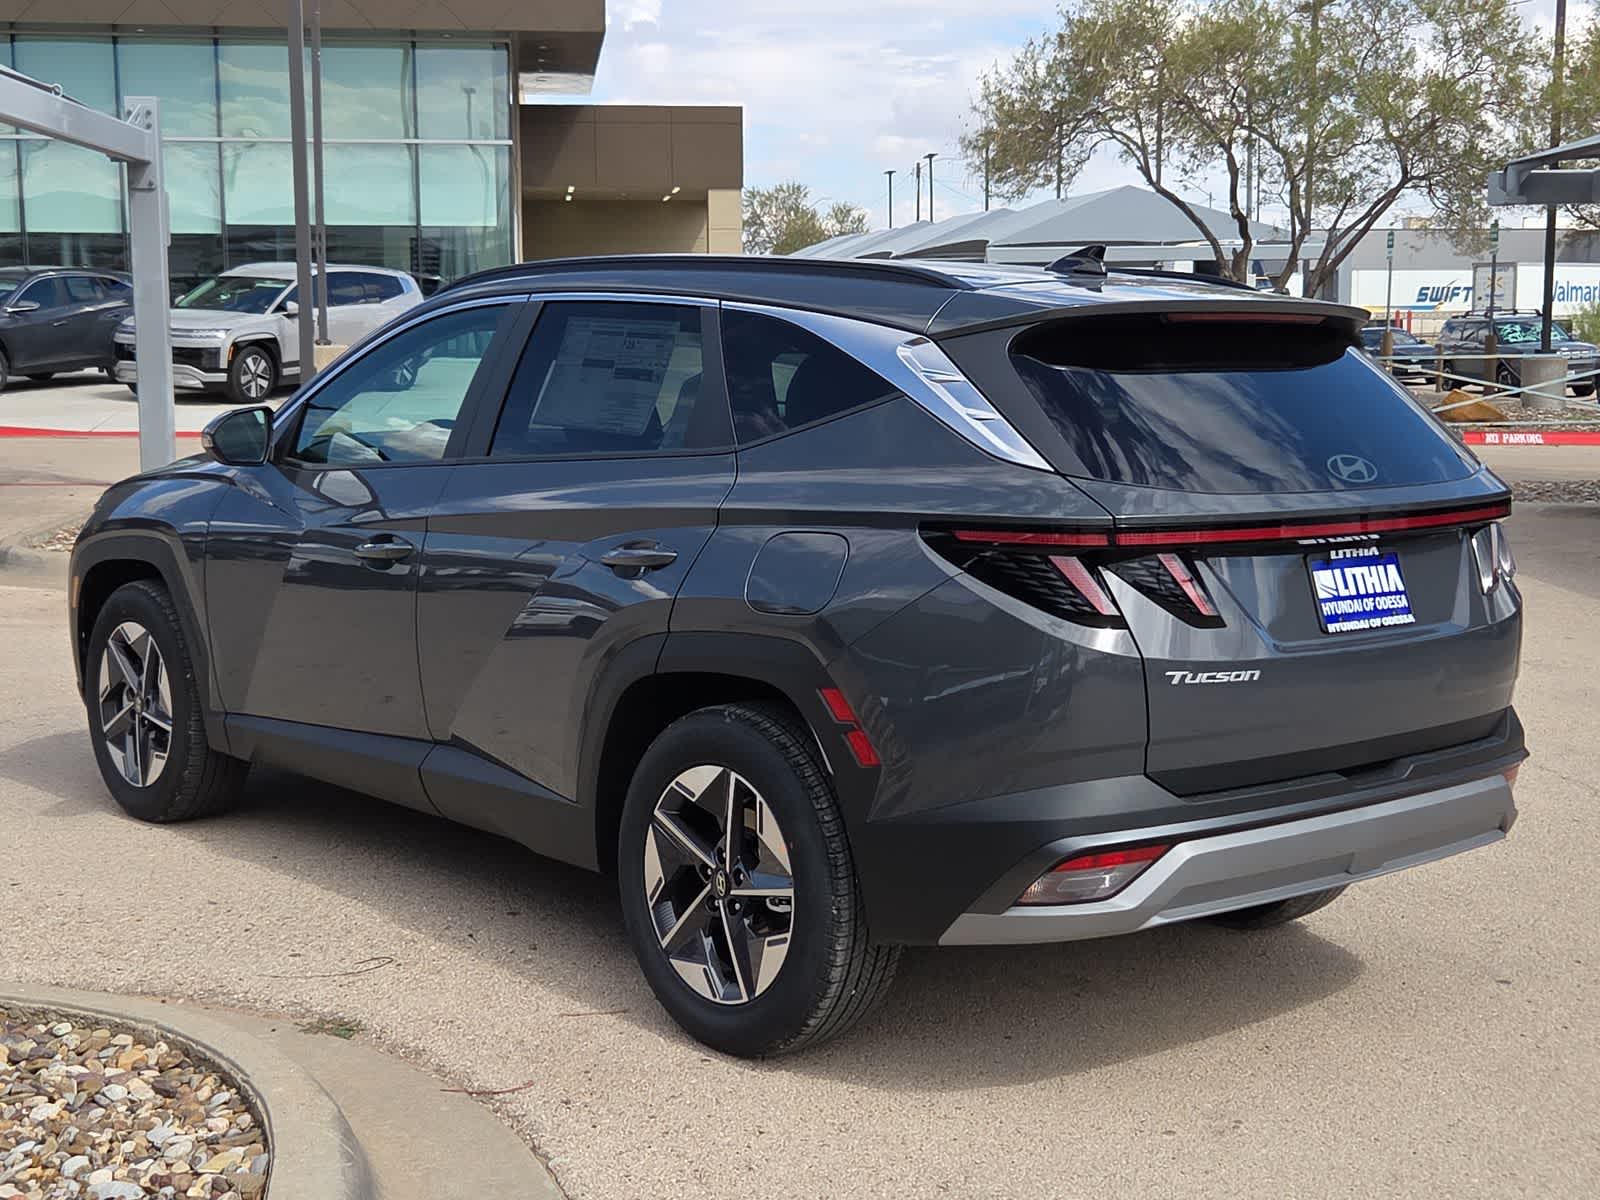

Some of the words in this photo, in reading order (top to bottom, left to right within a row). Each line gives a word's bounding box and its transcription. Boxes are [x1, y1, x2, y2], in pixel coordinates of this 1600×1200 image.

[1416, 284, 1472, 303] SWIFT
[1552, 281, 1600, 301] almar
[1485, 433, 1499, 444] NO
[1502, 433, 1544, 444] PARKING
[1330, 546, 1379, 560] LITHIA
[1333, 564, 1405, 596] LITHIA
[1321, 598, 1363, 616] HYUNDAI
[1363, 597, 1375, 611] OF
[1375, 594, 1409, 610] ODESSA
[1327, 619, 1370, 633] HYUNDAI
[1369, 617, 1382, 627] OF
[1381, 614, 1416, 626] ODESSA
